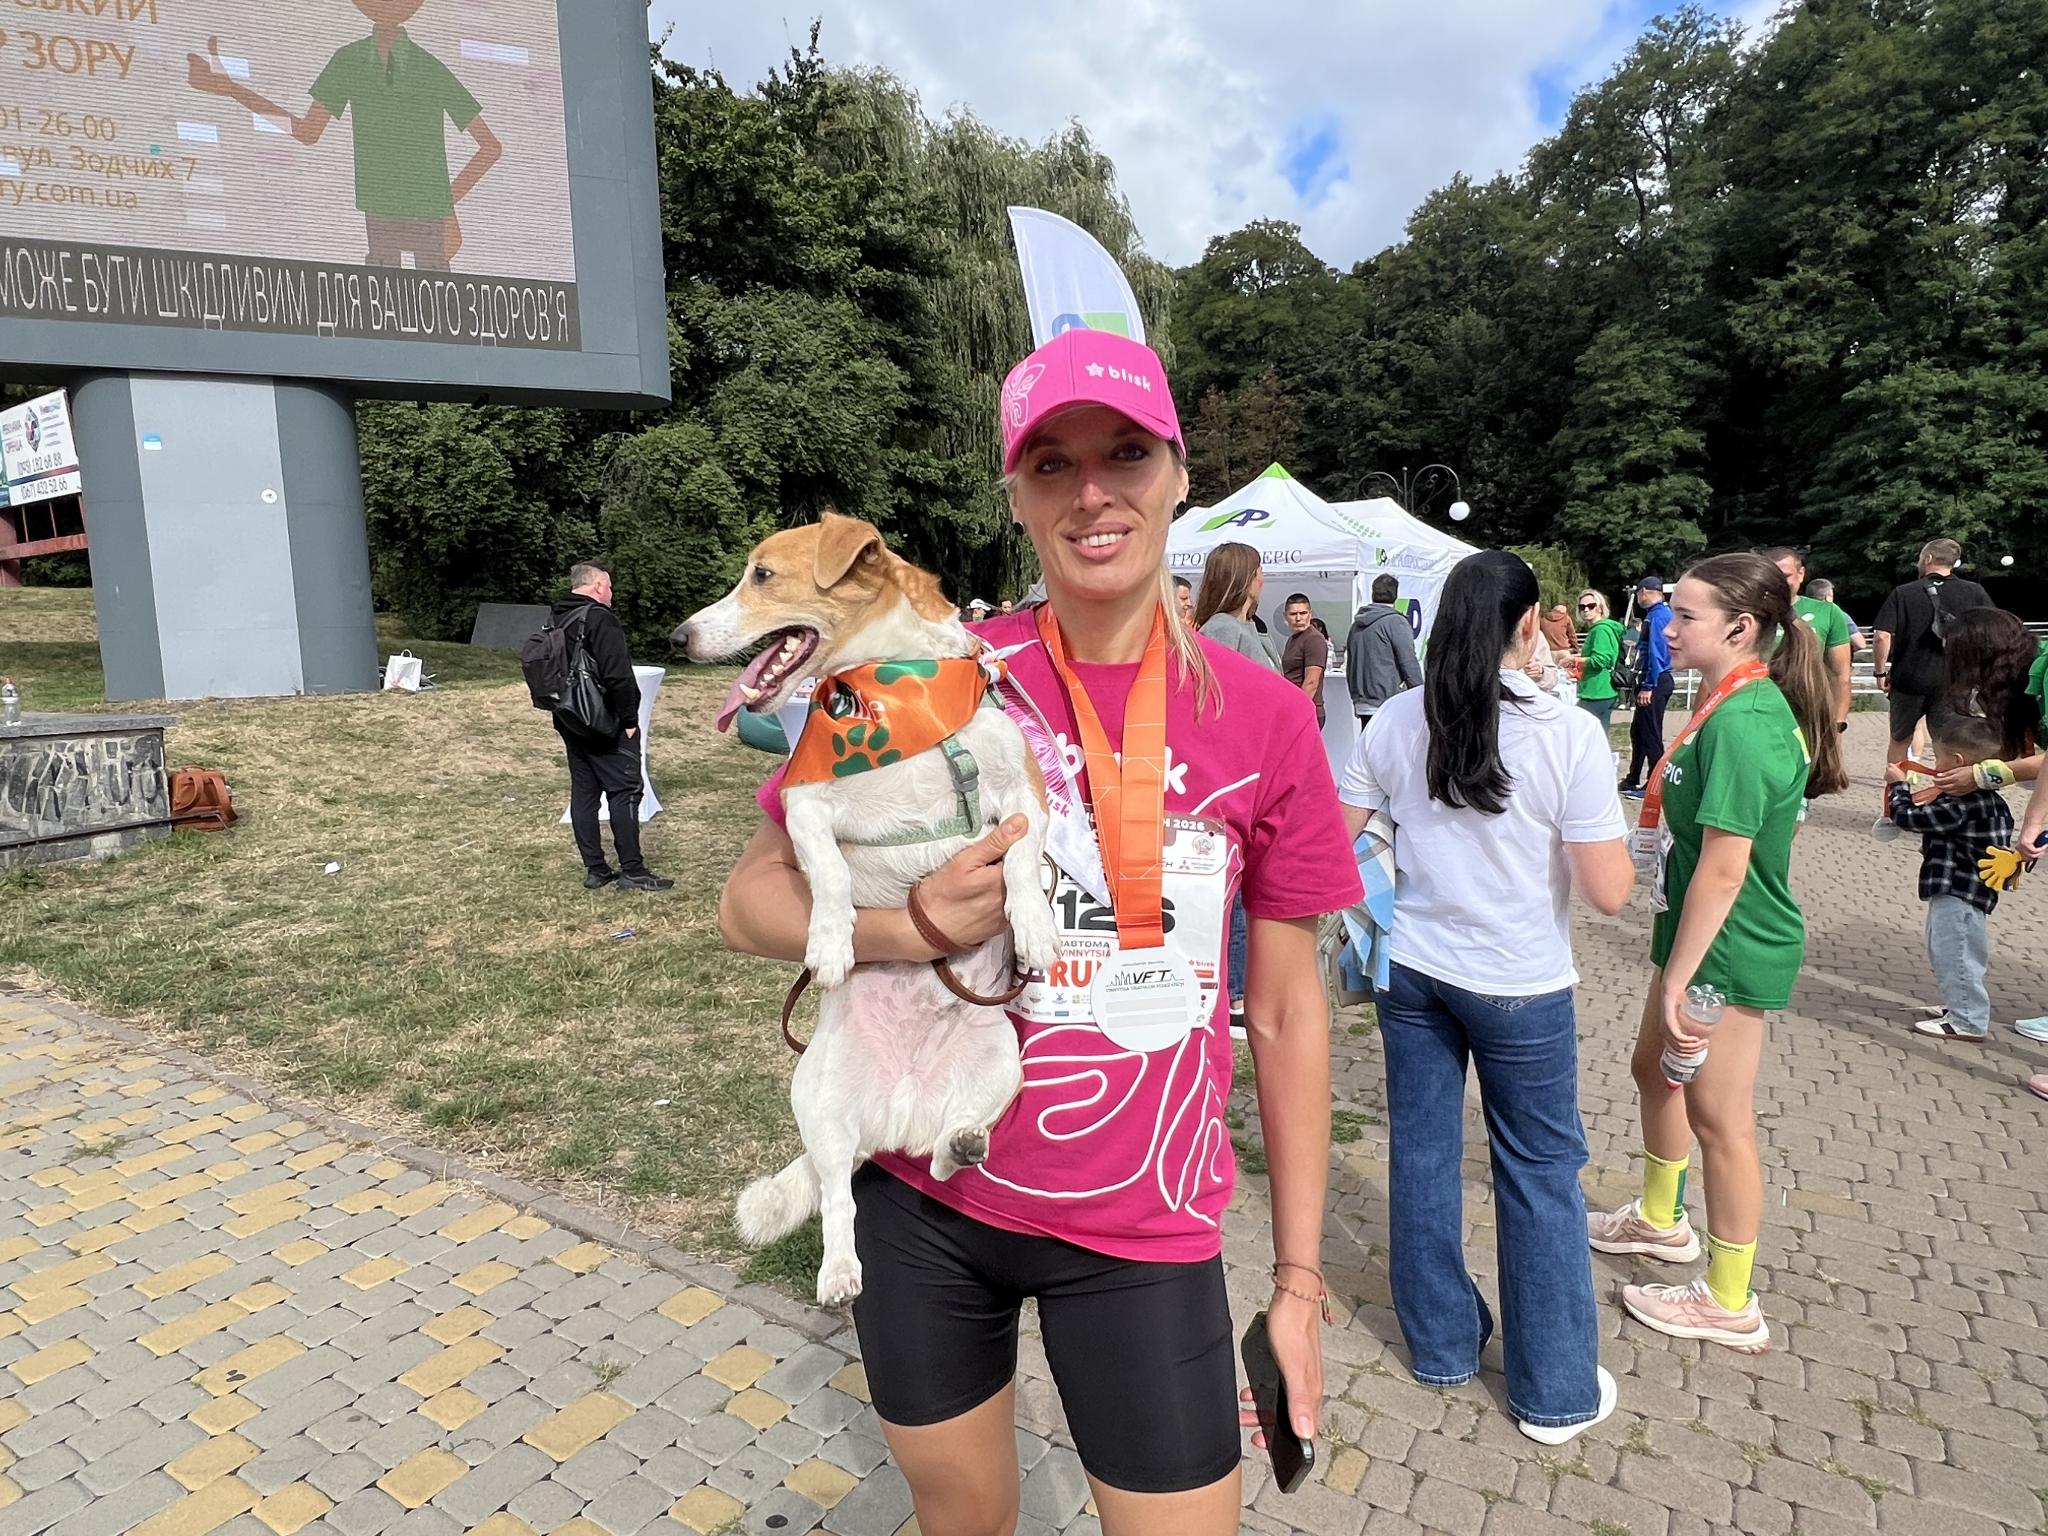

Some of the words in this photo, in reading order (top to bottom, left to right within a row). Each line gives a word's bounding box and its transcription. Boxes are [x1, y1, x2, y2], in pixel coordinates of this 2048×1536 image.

[19, 31, 136, 80] ЗОРУ
[70, 145, 176, 180] Зодчих
[182, 157, 198, 181] 7
[0, 248, 77, 311] МОЖЕ
[82, 253, 147, 316] БУТИ
[152, 257, 309, 331] ШКІДЛИВИМ
[317, 271, 363, 337] ДЛЯ
[367, 275, 461, 336] ВАШОГО
[466, 282, 569, 347] ЗДОРОВ'Я
[1174, 818, 1205, 831] 2026
[1060, 949, 1111, 957] VINNYTSIA
[1050, 959, 1102, 987] RU
